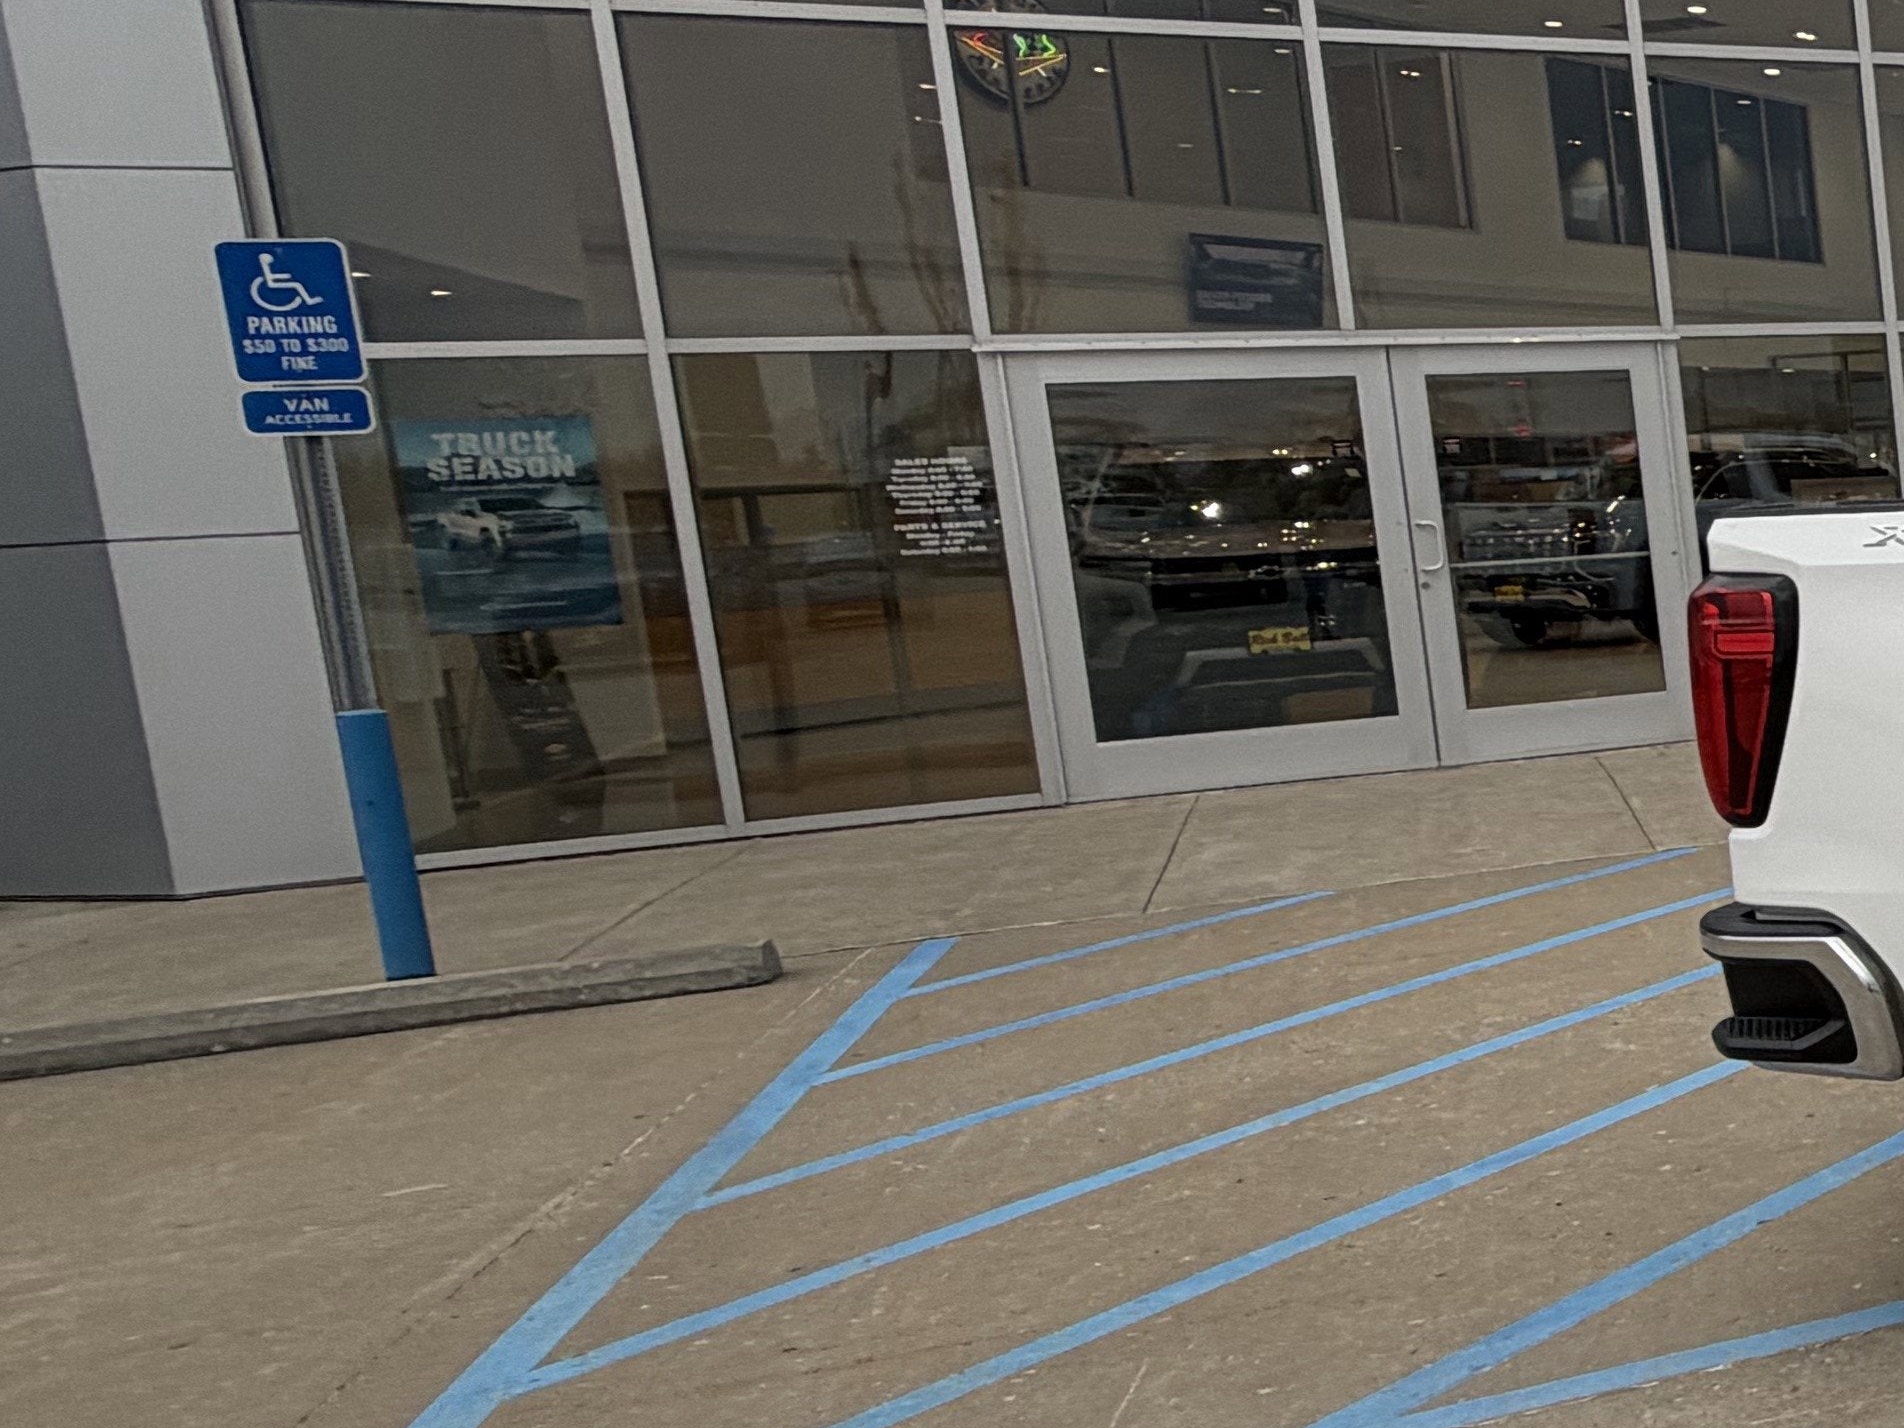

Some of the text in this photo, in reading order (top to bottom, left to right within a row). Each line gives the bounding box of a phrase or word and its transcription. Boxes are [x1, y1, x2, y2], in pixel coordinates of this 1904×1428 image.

[246, 315, 338, 334] PARKING
[242, 337, 349, 354] $50 TO $300
[281, 355, 318, 371] FINE
[283, 397, 330, 412] VAN
[264, 412, 353, 424] ACCESSIBLE
[430, 430, 559, 457] TRUCK
[426, 455, 576, 481] SEASON
